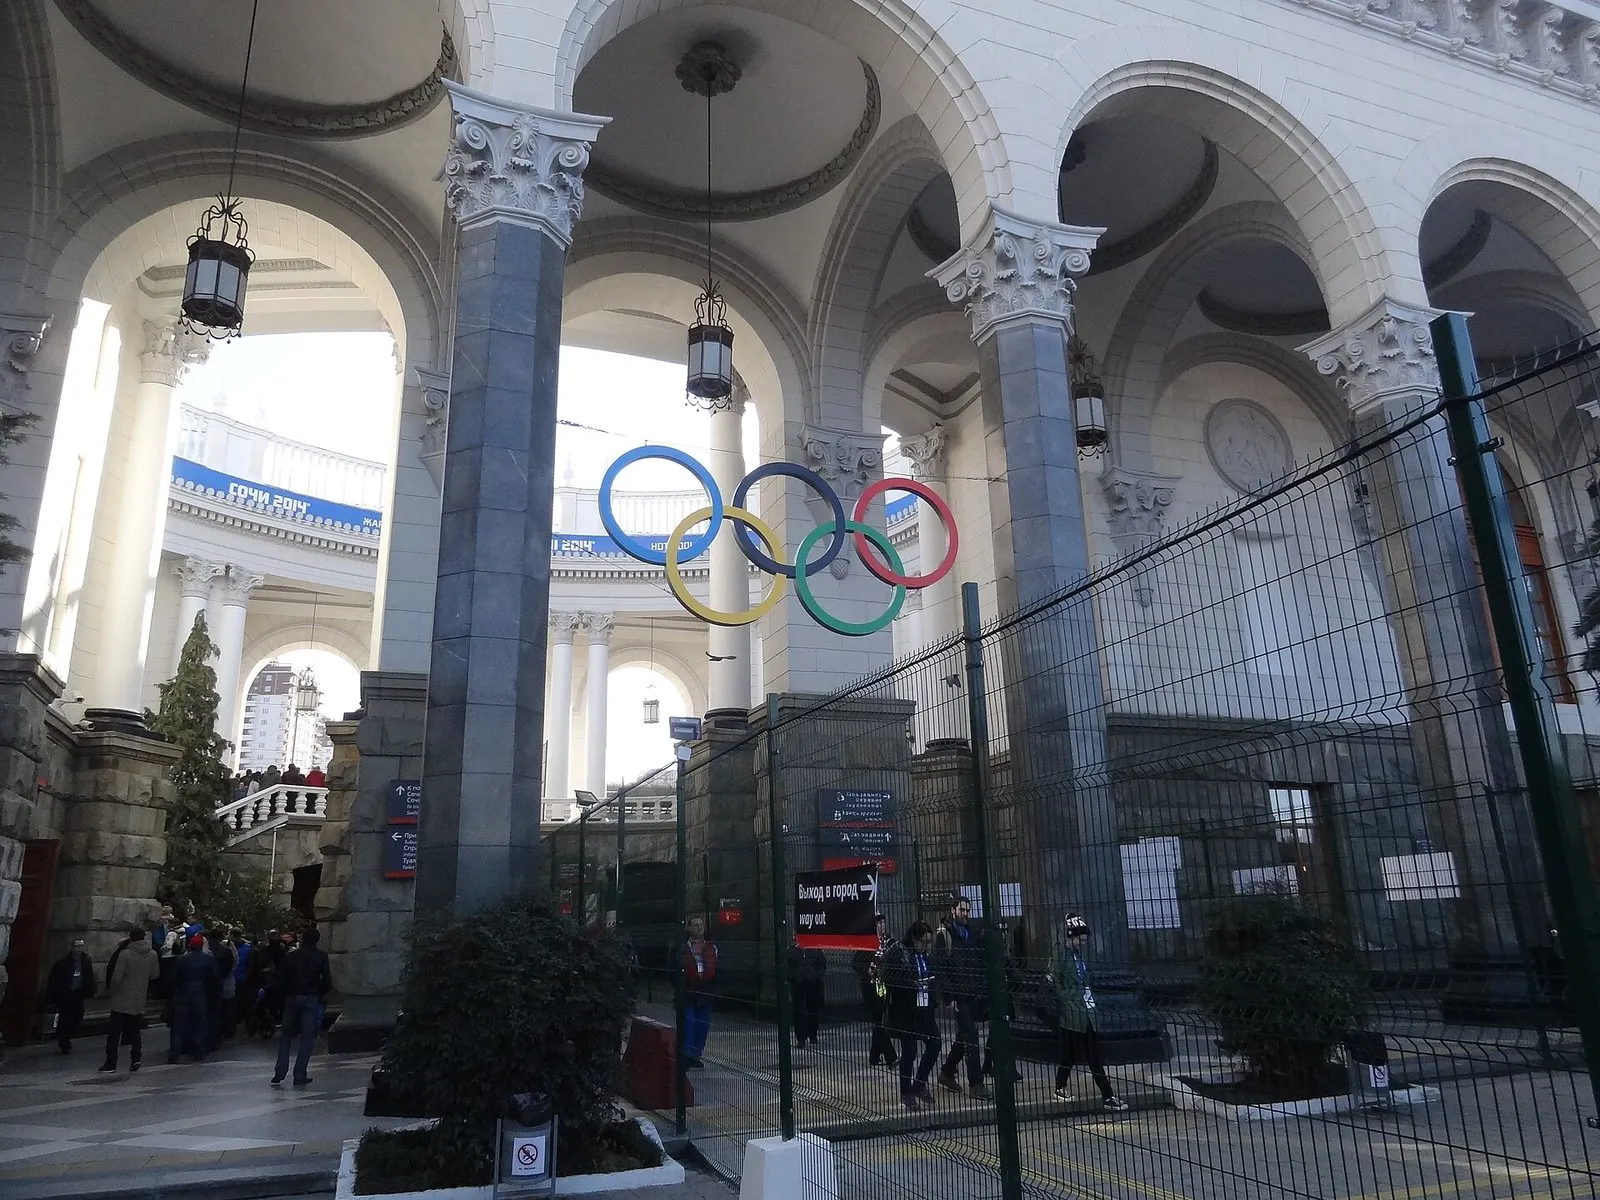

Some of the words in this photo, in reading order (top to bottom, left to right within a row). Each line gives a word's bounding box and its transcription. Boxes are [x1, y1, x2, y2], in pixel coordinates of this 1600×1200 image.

[273, 497, 307, 514] 2014
[562, 540, 592, 552] 2014
[798, 883, 824, 902] Выход
[826, 886, 831, 898] в
[833, 883, 859, 902] город
[799, 913, 814, 929] way
[815, 911, 826, 925] out
